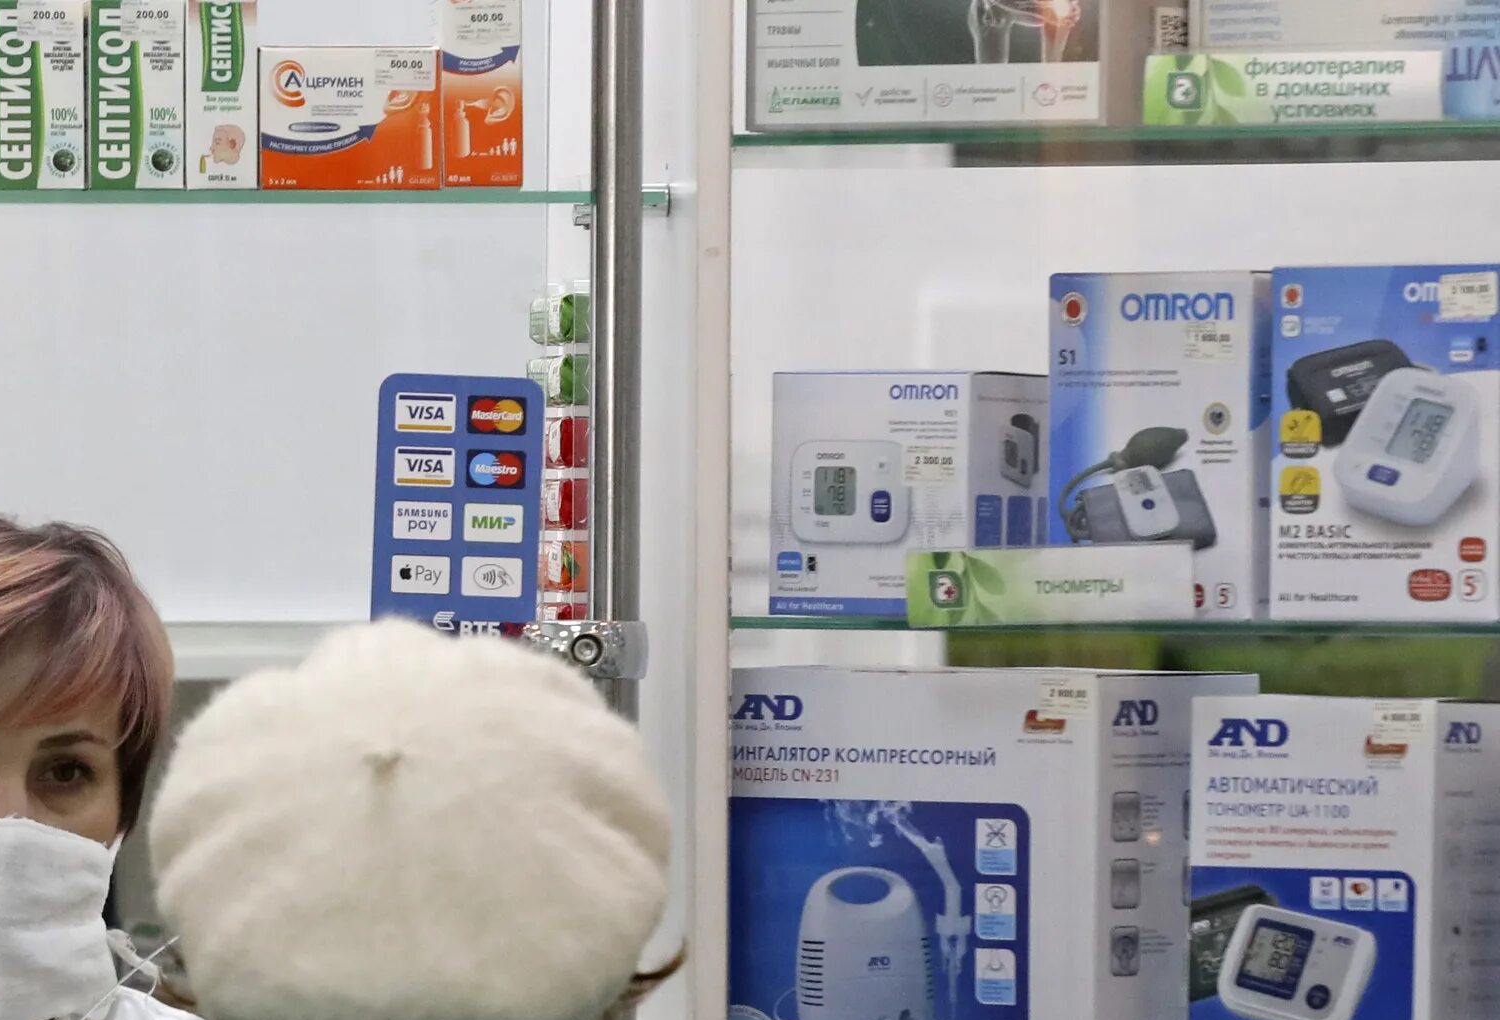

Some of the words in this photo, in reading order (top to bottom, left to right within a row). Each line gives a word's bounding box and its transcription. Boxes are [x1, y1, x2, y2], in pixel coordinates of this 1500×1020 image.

[211, 0, 232, 83] СЕПТИС
[1244, 57, 1406, 76] физиотерапия
[1256, 83, 1268, 96] в
[1275, 81, 1391, 99] домашних
[50, 107, 78, 121] 100%
[149, 107, 177, 121] 100%
[1272, 102, 1377, 122] условиях
[1121, 292, 1234, 321] OMRON
[1059, 350, 1077, 364] S1
[889, 384, 959, 400] OMRON
[406, 405, 445, 420] VISA
[471, 408, 522, 422] MasterCard
[407, 457, 444, 474] VISA
[475, 463, 517, 476] Maestro
[397, 508, 449, 518] SAMSUNG
[408, 519, 437, 533] pay
[471, 516, 516, 530] МИР
[1280, 525, 1302, 538] M2
[1307, 525, 1352, 539] BASIC
[415, 565, 443, 585] Pay
[1036, 579, 1124, 597] тонометры
[1464, 576, 1476, 595] 5
[1219, 588, 1228, 603] 5
[459, 621, 500, 637] ВТБ
[734, 746, 830, 763] ИНГАЛЯТОР
[835, 747, 996, 766] КОМПРЕССОРНЫЙ
[733, 767, 788, 782] МОДЕЛЬ
[792, 769, 840, 782] CN-231
[1207, 776, 1379, 796] АВТОМАТИЧЕСКИЙ
[1207, 802, 1285, 818] ТОНОМЕТР
[1287, 804, 1350, 819] UA-1100
